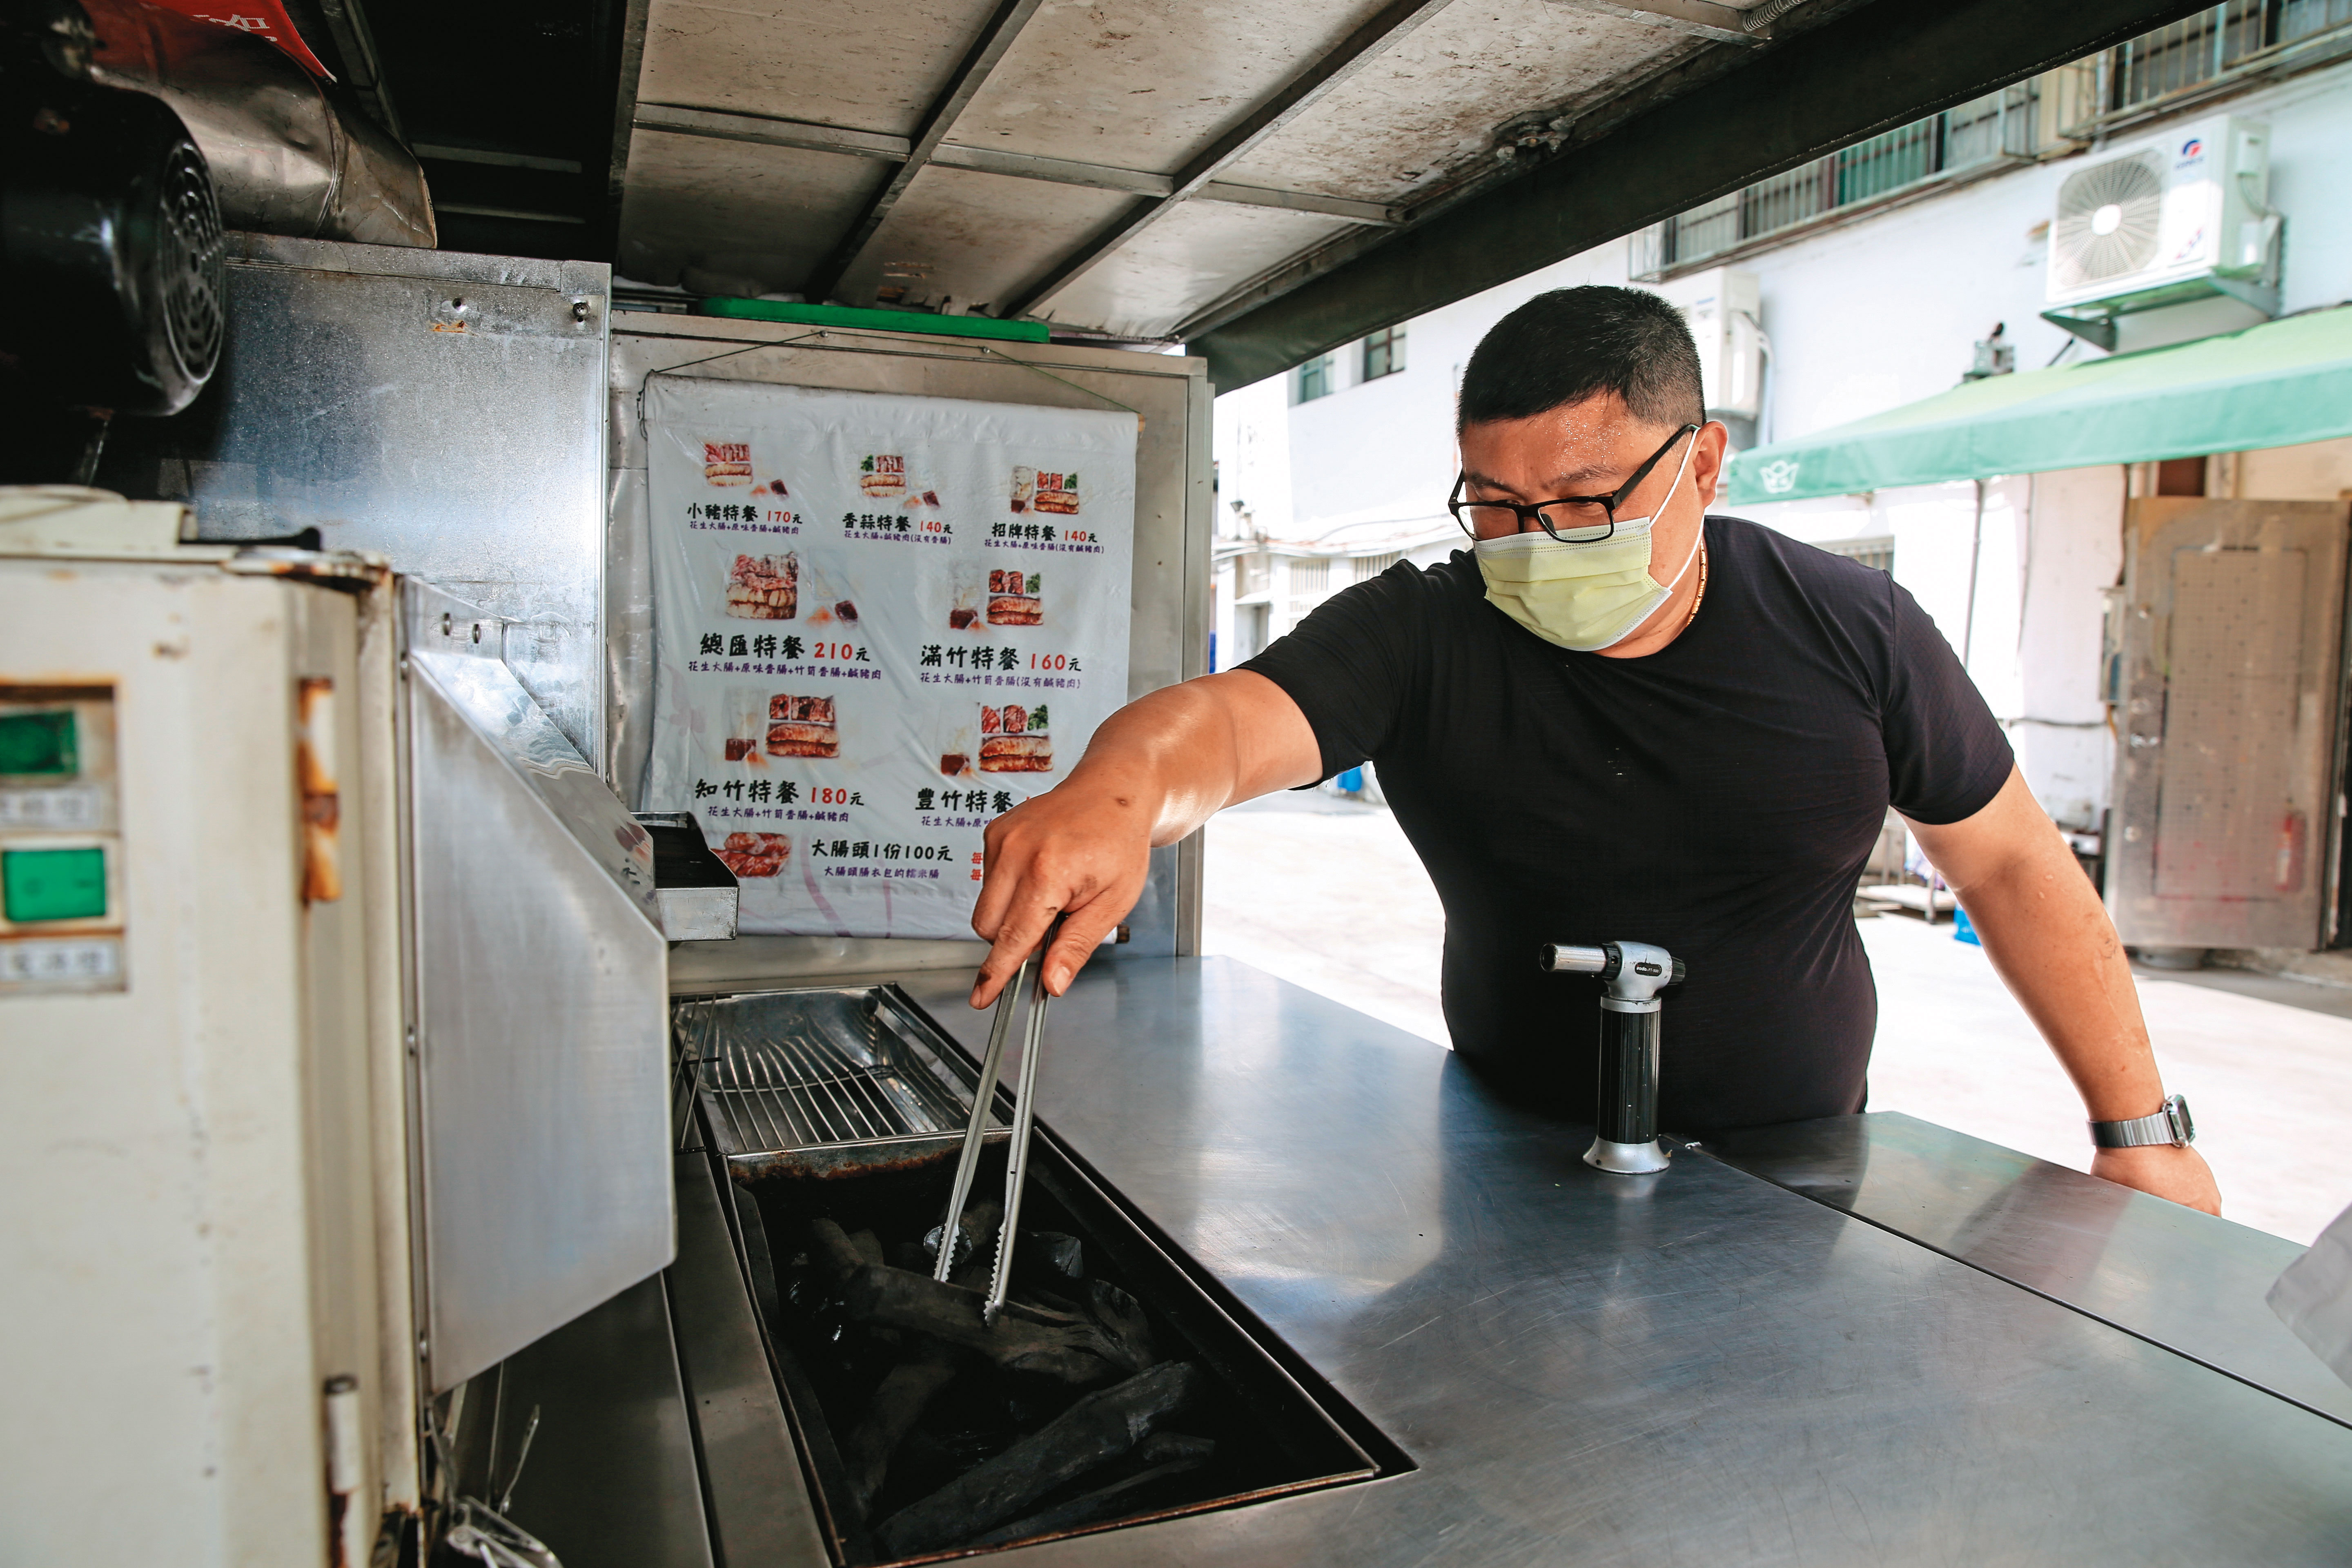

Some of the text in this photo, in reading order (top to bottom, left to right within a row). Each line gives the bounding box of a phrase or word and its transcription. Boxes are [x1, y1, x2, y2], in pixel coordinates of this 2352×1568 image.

[687, 503, 802, 525] 小豬特餐 170元
[842, 512, 953, 535] 香蒜特餐 140元
[991, 523, 1097, 543] 招牌特餐 140元
[700, 633, 870, 662] 總匯特餐 210元
[920, 644, 1081, 672] 滿竹特餐 160元
[695, 779, 864, 806] 知竹特餐 180元
[915, 786, 1014, 813] 豐竹特餐
[812, 839, 953, 861] 大腸頭1份100元
[972, 851, 983, 865] 每
[825, 866, 939, 878] 大腸頭腸衣包的糯米腸
[971, 868, 982, 882] 每
